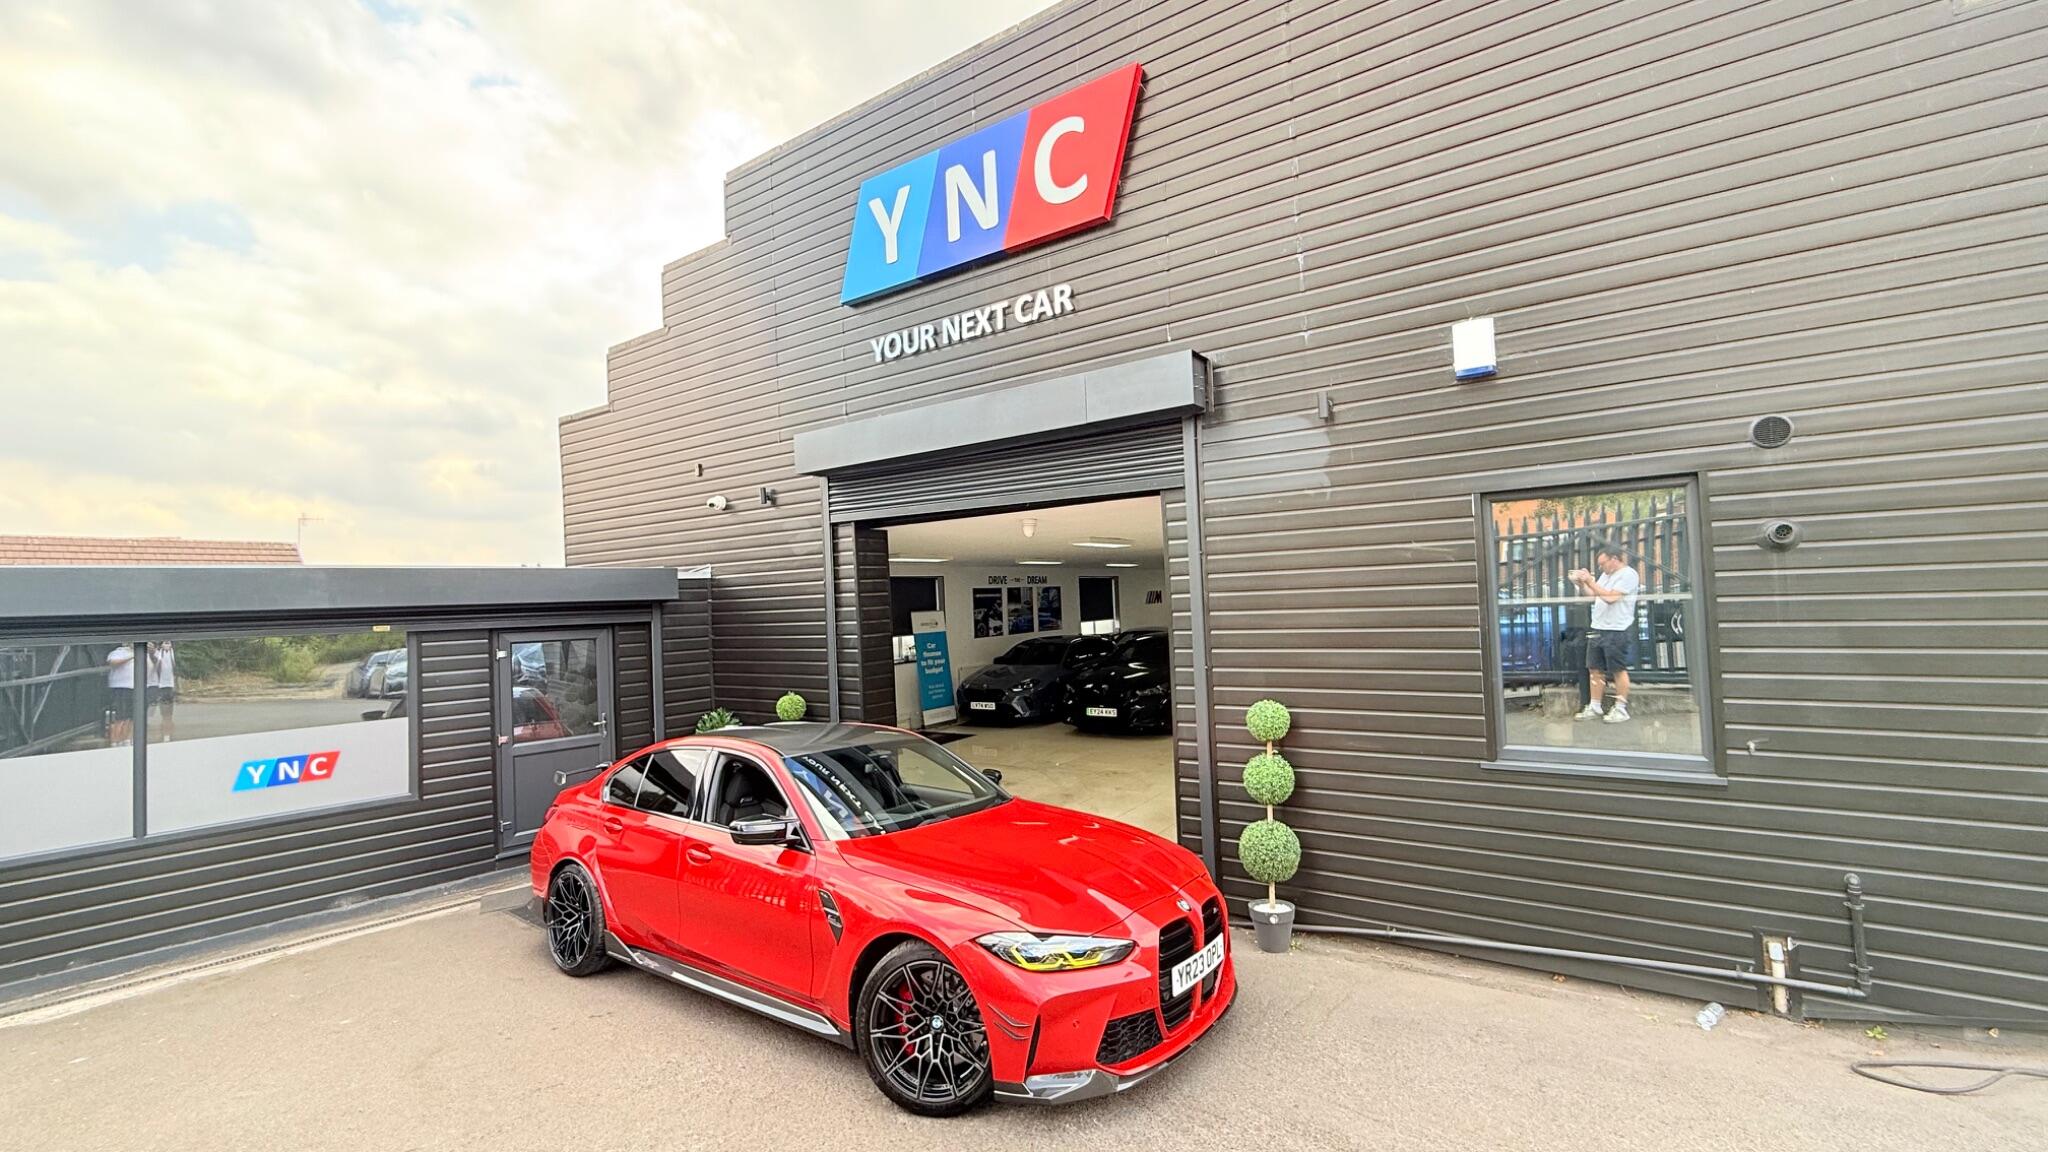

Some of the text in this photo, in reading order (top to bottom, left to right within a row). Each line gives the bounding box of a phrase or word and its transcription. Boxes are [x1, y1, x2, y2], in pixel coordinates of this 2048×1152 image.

[868, 116, 1087, 264] YNC
[871, 284, 1075, 362] YOUR NEXT CAR
[988, 575, 1008, 585] DRIVE
[1027, 575, 1048, 585] DREAM
[246, 757, 328, 785] YNC
[1177, 941, 1222, 988] YR23 OPL
